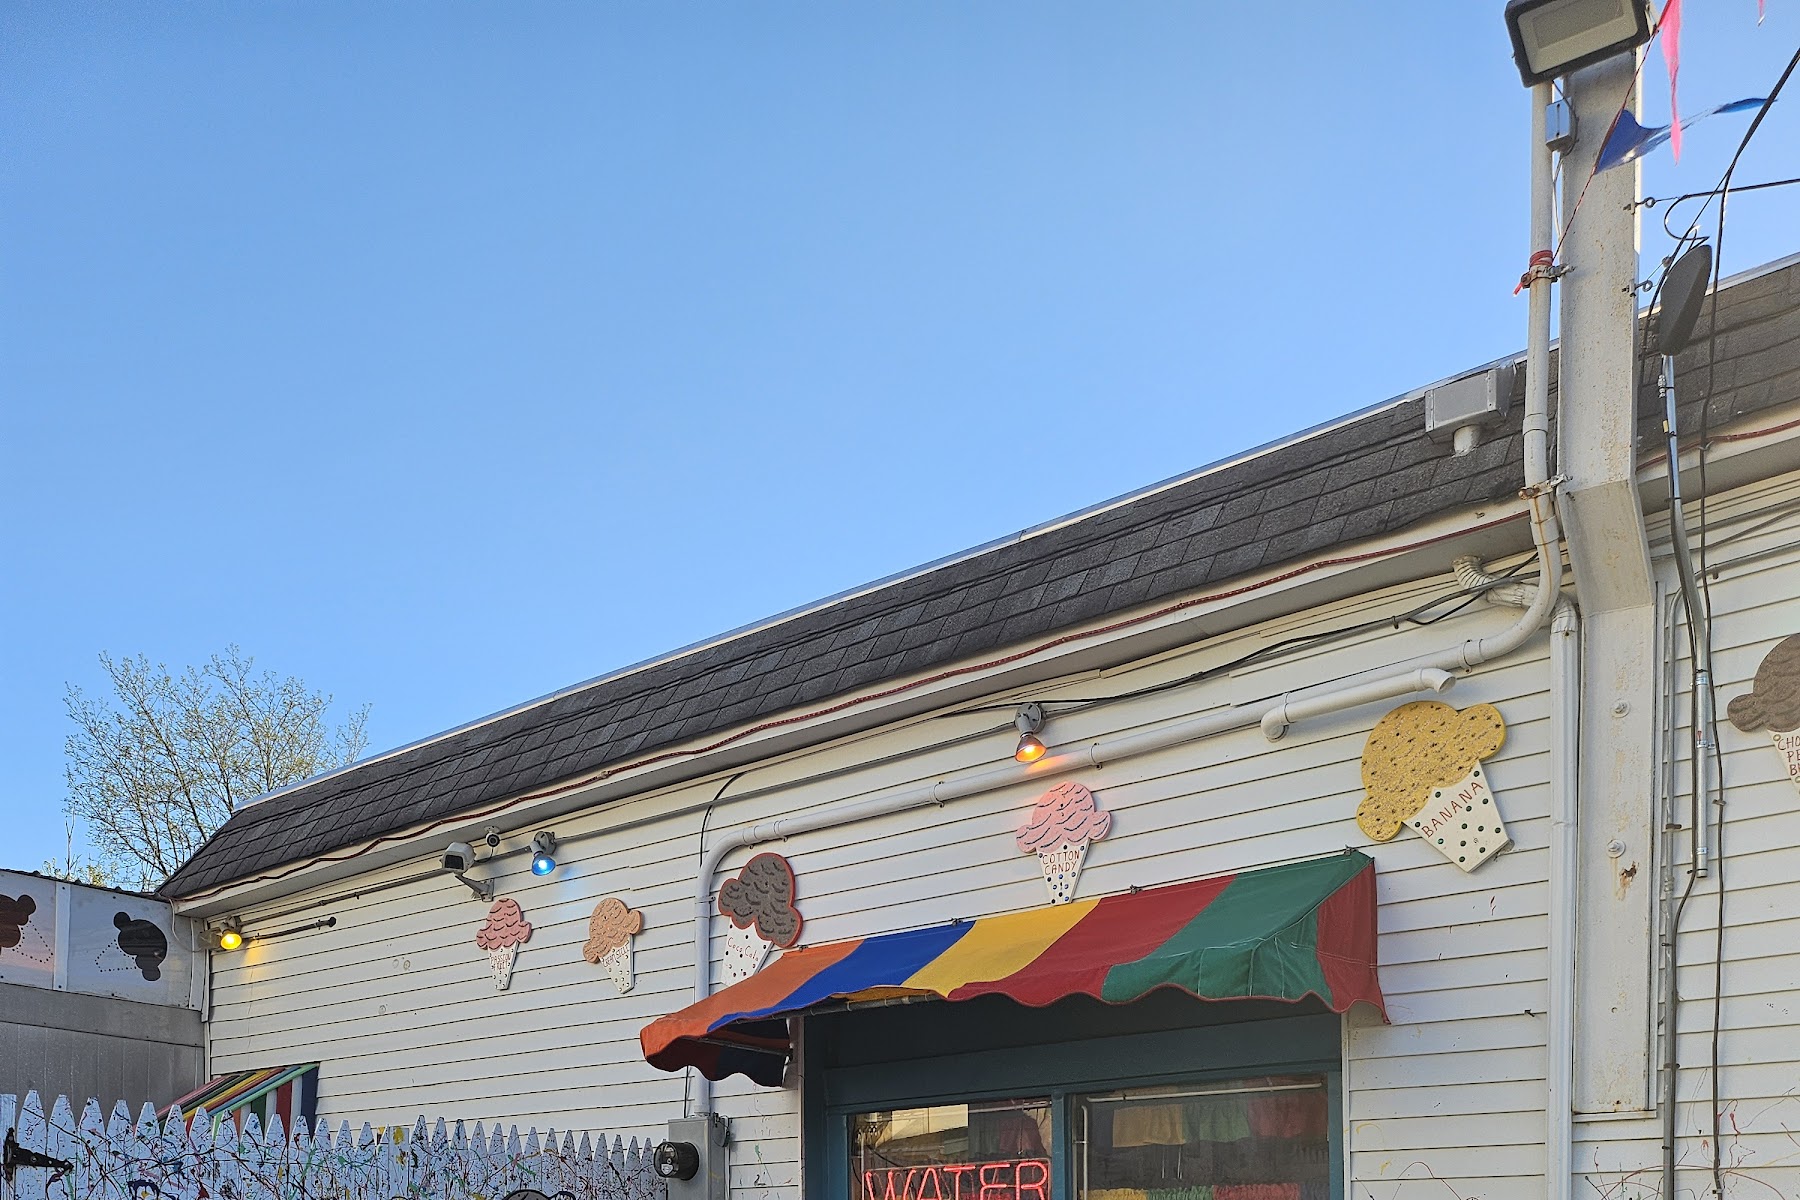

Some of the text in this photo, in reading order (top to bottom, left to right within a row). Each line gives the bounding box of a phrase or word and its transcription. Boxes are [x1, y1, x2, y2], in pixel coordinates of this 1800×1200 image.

[1420, 781, 1484, 838] BANANA
[1042, 849, 1081, 865] COTTON
[1044, 860, 1078, 876] CANDY
[727, 936, 759, 962] Coca Cola
